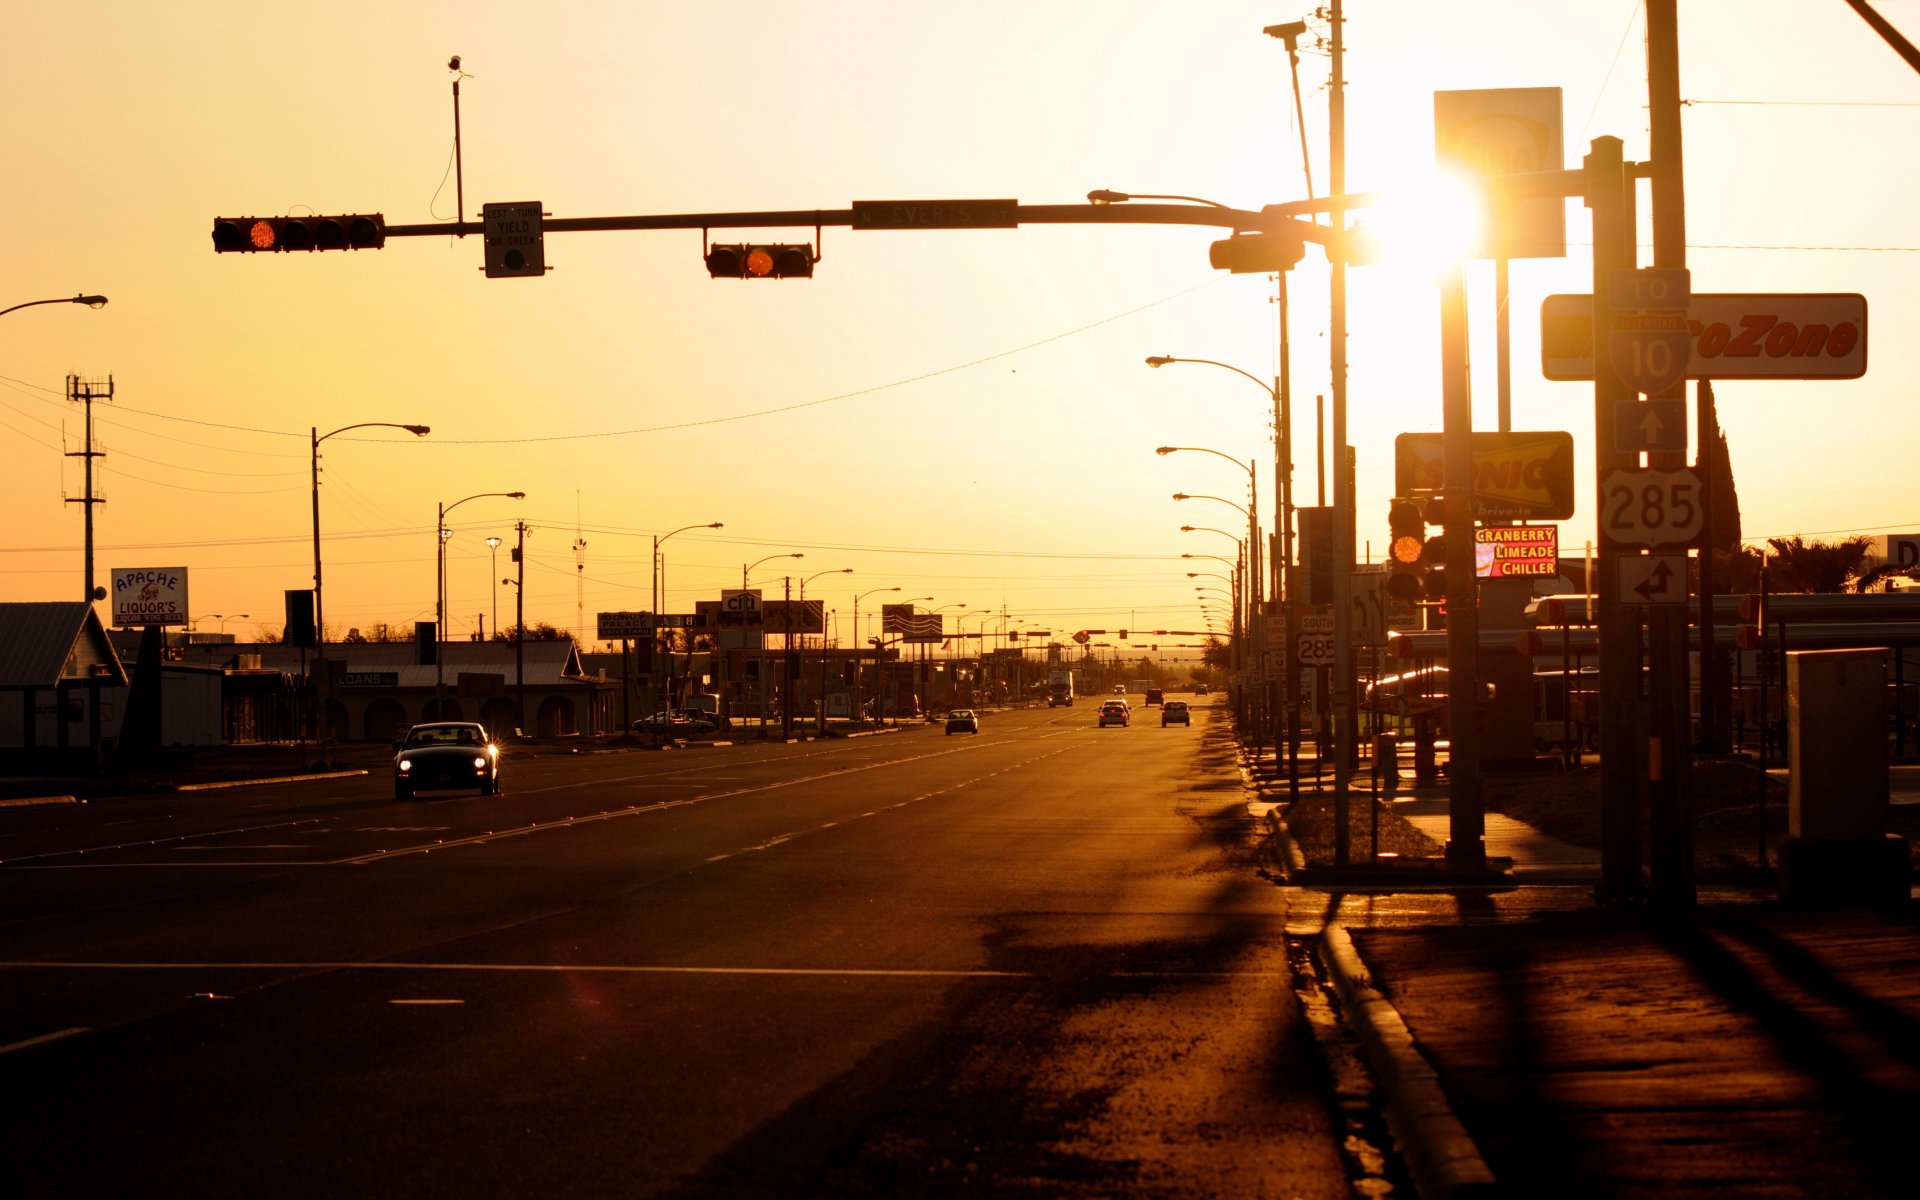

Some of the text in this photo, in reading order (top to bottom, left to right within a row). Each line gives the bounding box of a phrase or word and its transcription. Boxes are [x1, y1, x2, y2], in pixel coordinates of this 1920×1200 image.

[487, 207, 539, 219] LEFT TURN
[892, 204, 970, 220] EVERTS
[497, 221, 529, 232] YIELD
[490, 236, 535, 247] ON GREEN
[1631, 277, 1669, 300] TO
[1630, 315, 1858, 358] oZone
[1632, 340, 1671, 377] 10
[1418, 457, 1550, 489] SNIC
[1610, 484, 1694, 529] 285
[1475, 529, 1554, 542] CRANBERRY
[1496, 546, 1555, 559] LIMEADE
[1502, 562, 1555, 575] CHILLER
[116, 571, 179, 591] APACHE
[120, 601, 177, 614] LIQUOR'S
[1303, 618, 1334, 628] SOUTH
[1300, 640, 1335, 658] 285
[338, 674, 381, 685] LOANS
